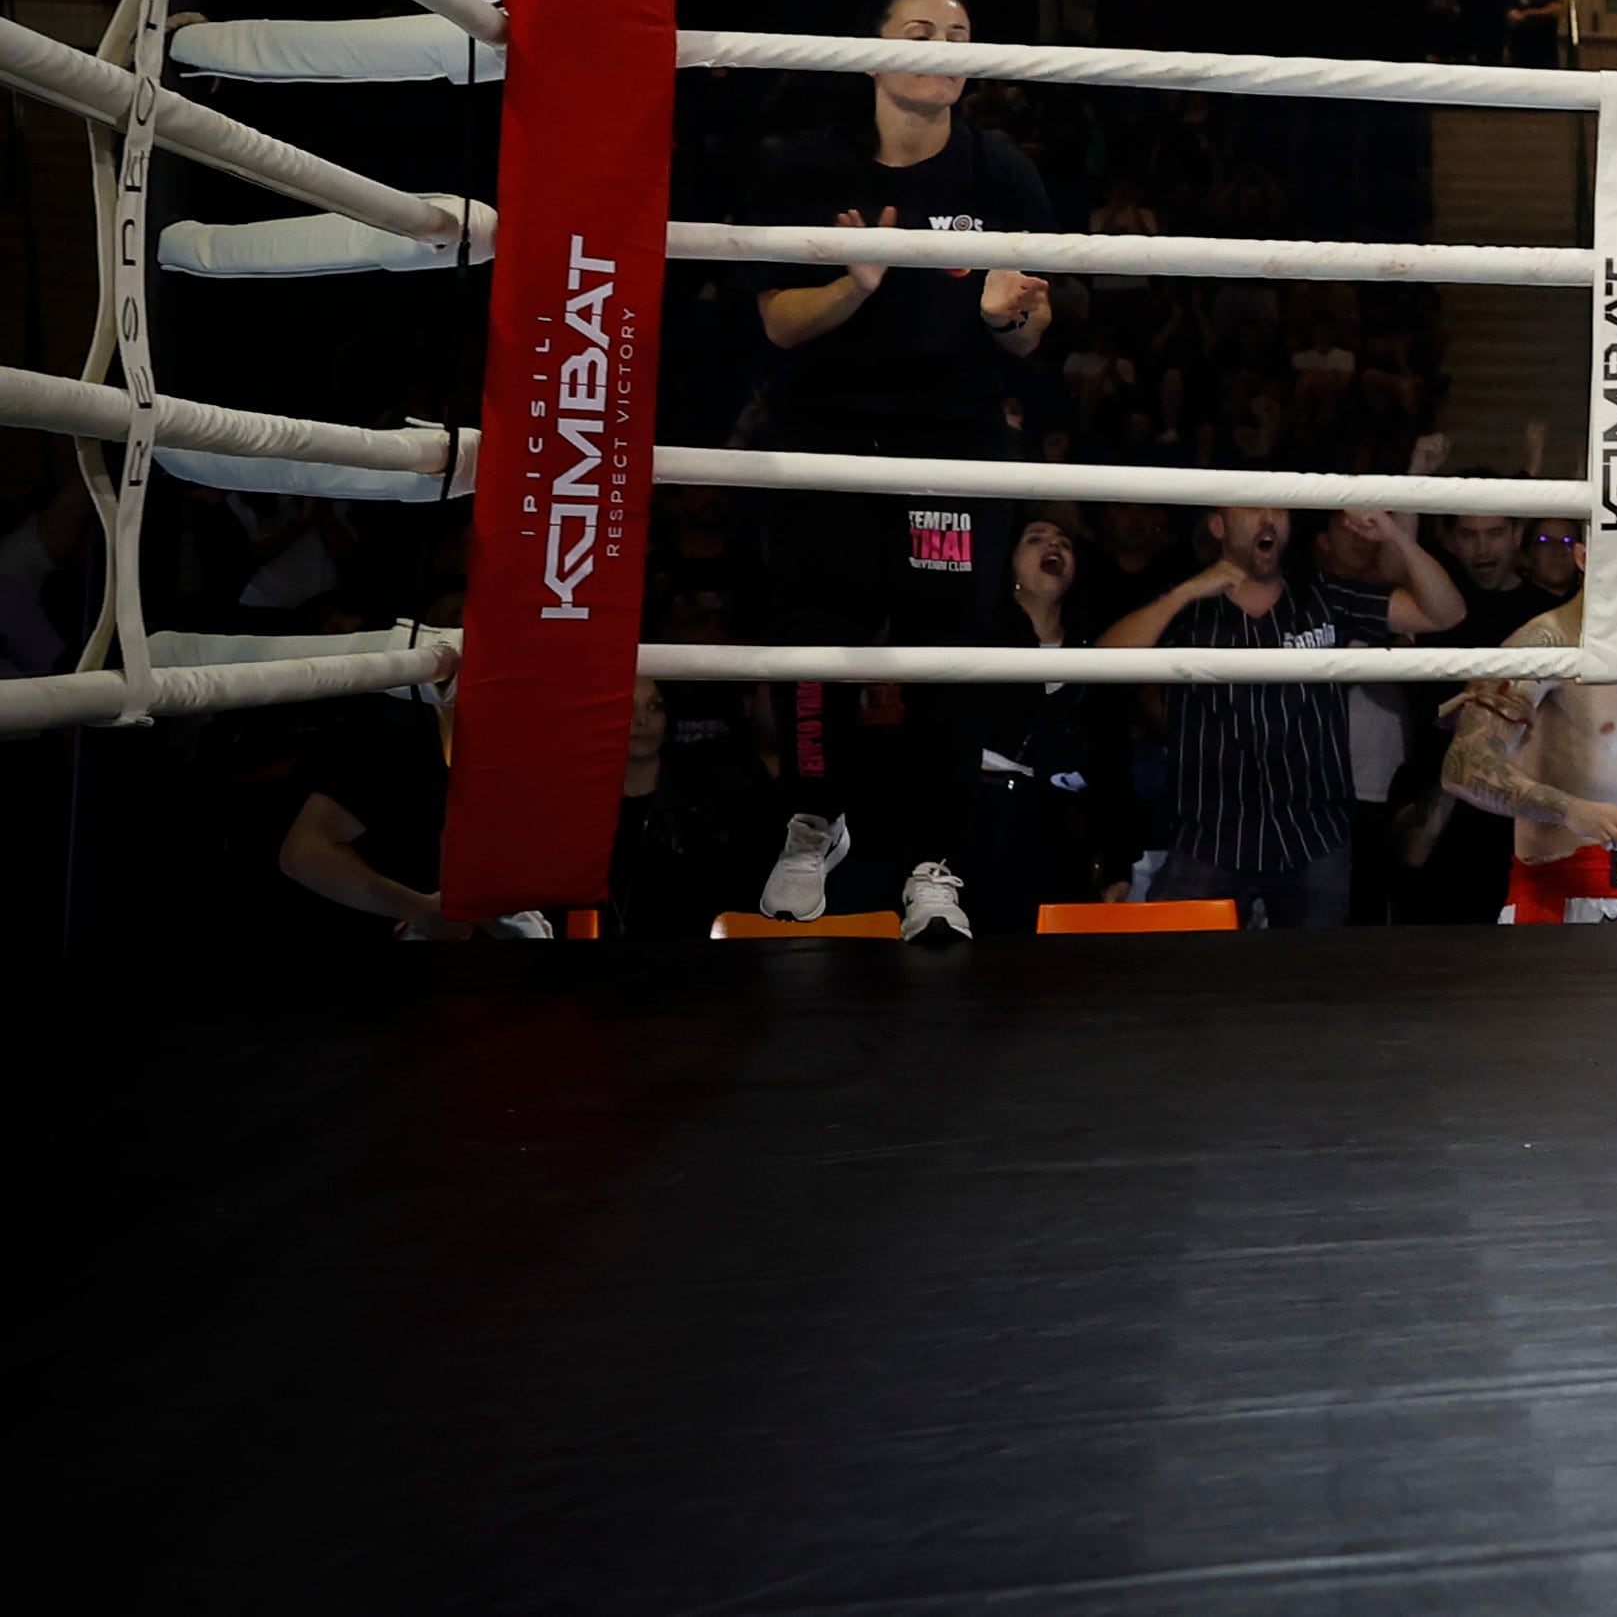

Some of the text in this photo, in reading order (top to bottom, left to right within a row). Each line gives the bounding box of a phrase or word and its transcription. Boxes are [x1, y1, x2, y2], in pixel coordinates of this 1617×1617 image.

[522, 337, 552, 514] PICSIL
[540, 233, 617, 620] KOMBAT
[606, 306, 637, 558] RESPECT VICTORY
[908, 510, 972, 531] TEMPLO
[908, 529, 972, 561] THAI
